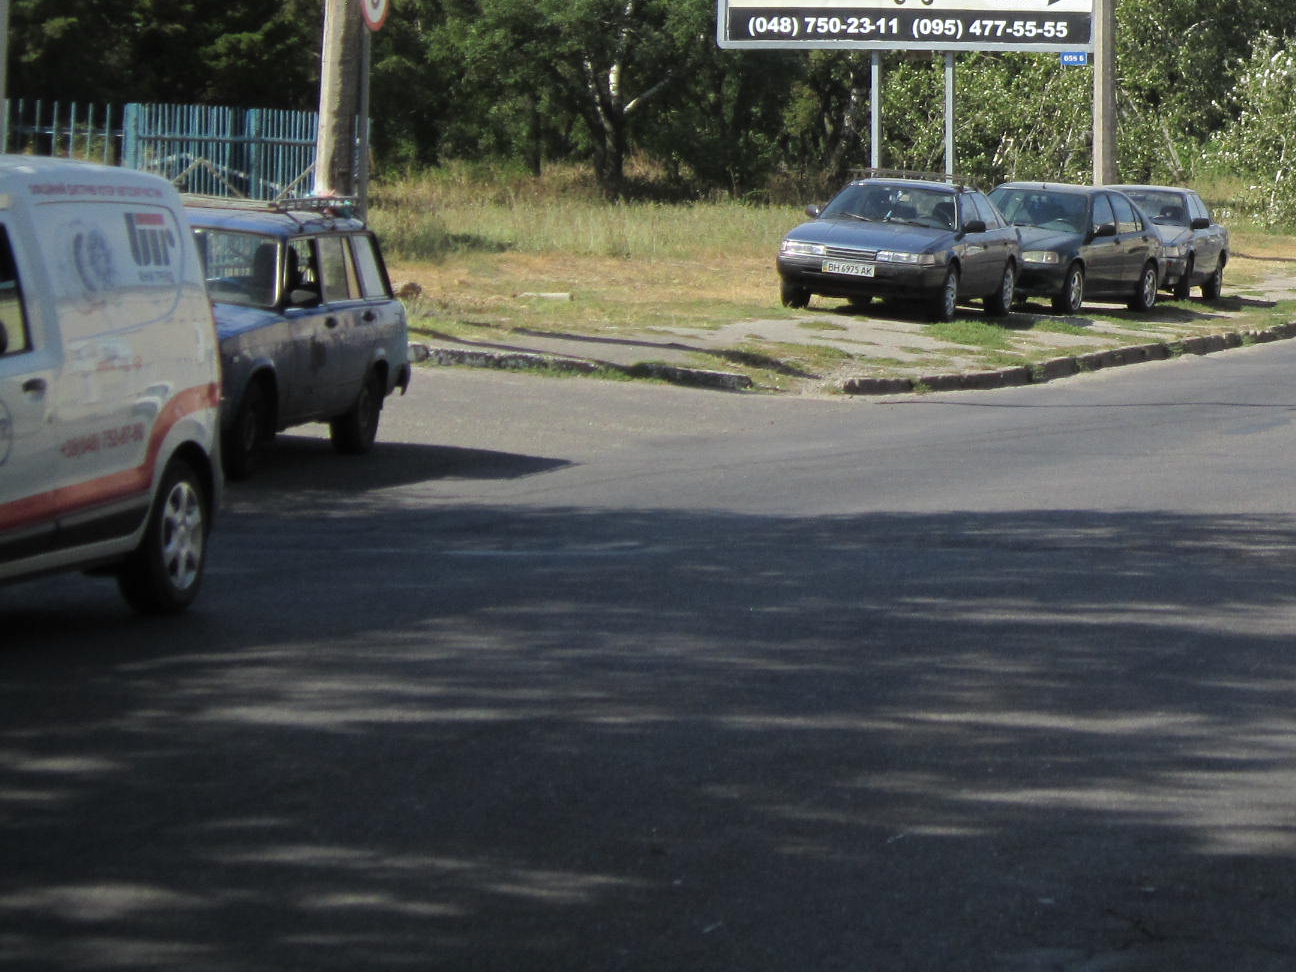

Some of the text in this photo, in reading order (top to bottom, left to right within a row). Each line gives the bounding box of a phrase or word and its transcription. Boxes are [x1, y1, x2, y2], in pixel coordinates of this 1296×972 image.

[748, 16, 1068, 39] (048) 750-23-11 (095) 477-55-55
